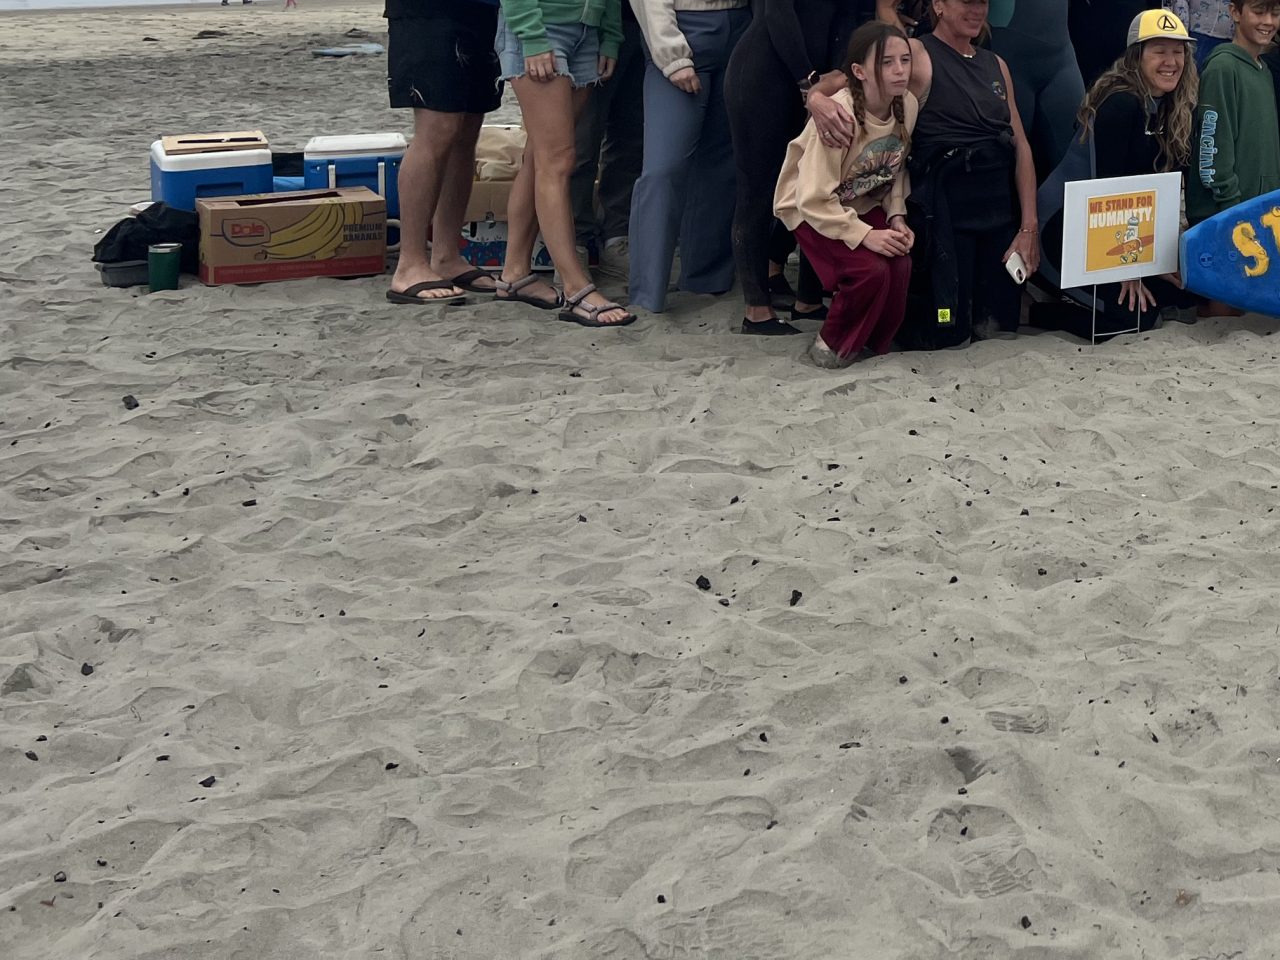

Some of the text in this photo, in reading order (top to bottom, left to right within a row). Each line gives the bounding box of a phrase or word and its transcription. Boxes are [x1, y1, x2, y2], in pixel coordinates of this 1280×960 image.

[1199, 109, 1219, 187] encinit
[1089, 195, 1153, 214] WE STAND FOR
[230, 222, 265, 236] Dole
[343, 223, 383, 232] PREMIUM
[343, 231, 384, 241] BANANAS
